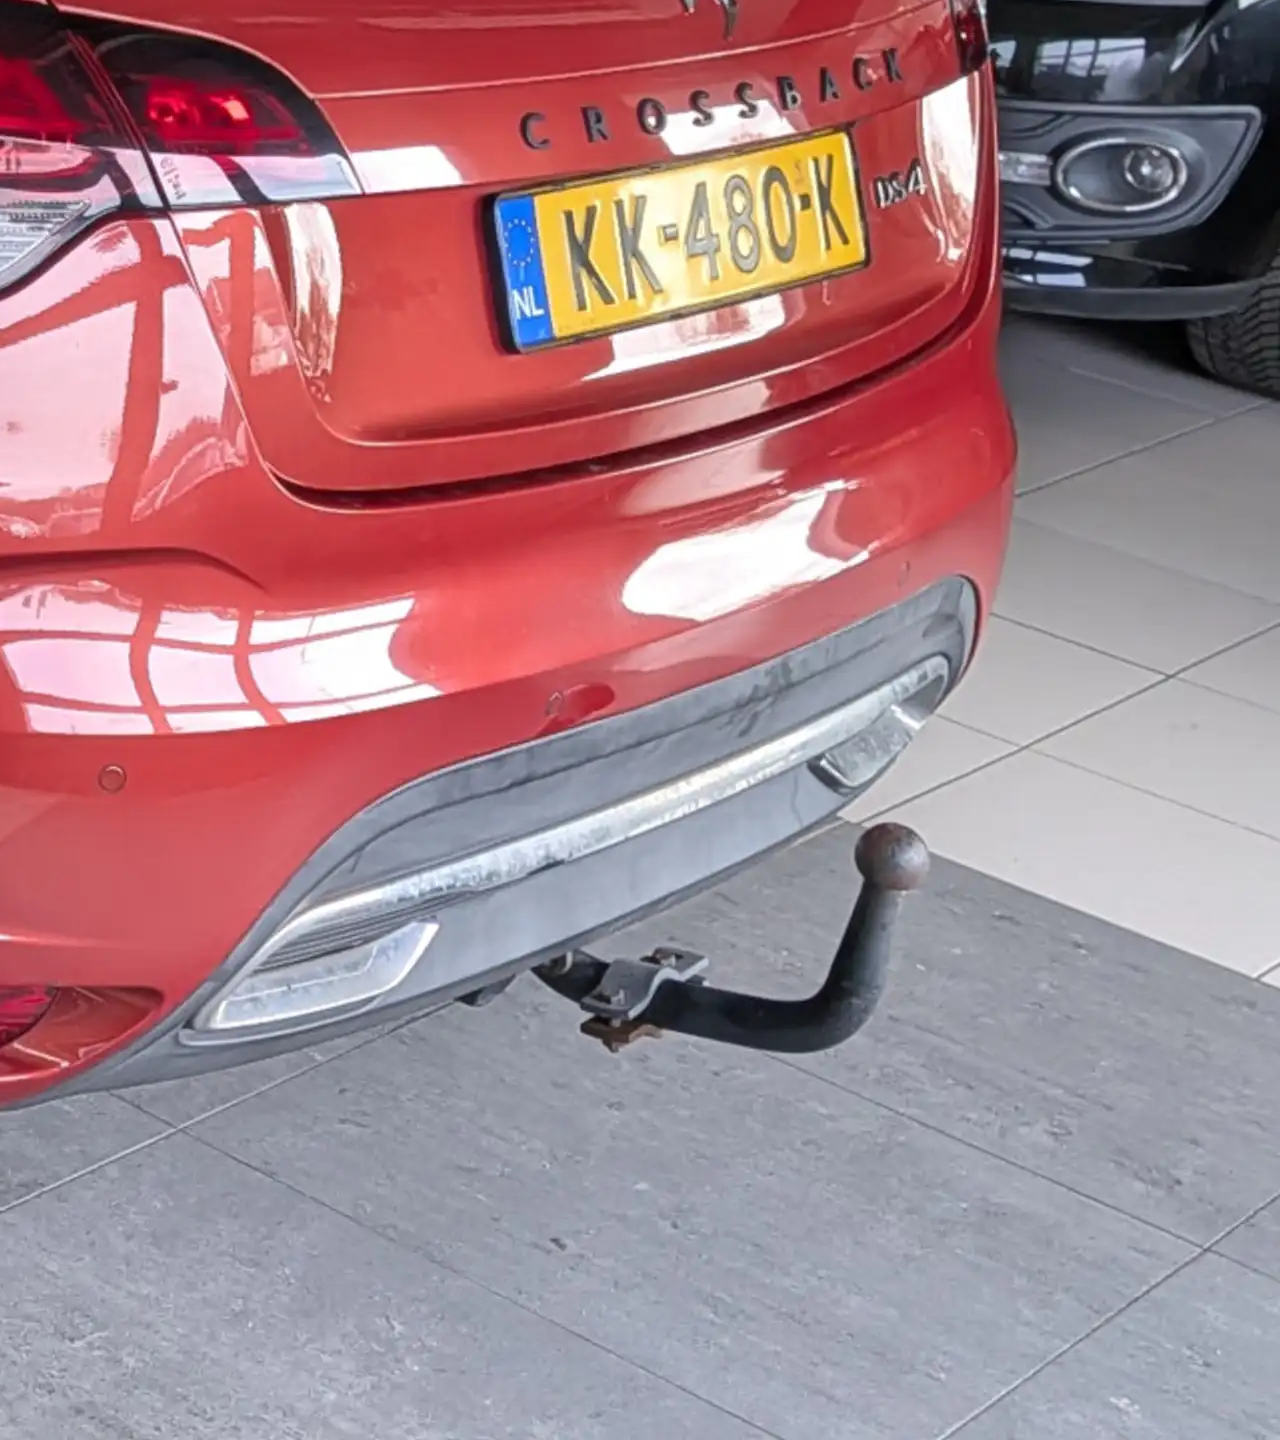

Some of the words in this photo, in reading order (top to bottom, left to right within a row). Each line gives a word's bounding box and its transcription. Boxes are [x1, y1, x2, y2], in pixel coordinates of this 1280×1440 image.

[520, 47, 903, 149] CROSSBACK
[563, 154, 850, 312] KK-480-K
[511, 285, 545, 320] NL
